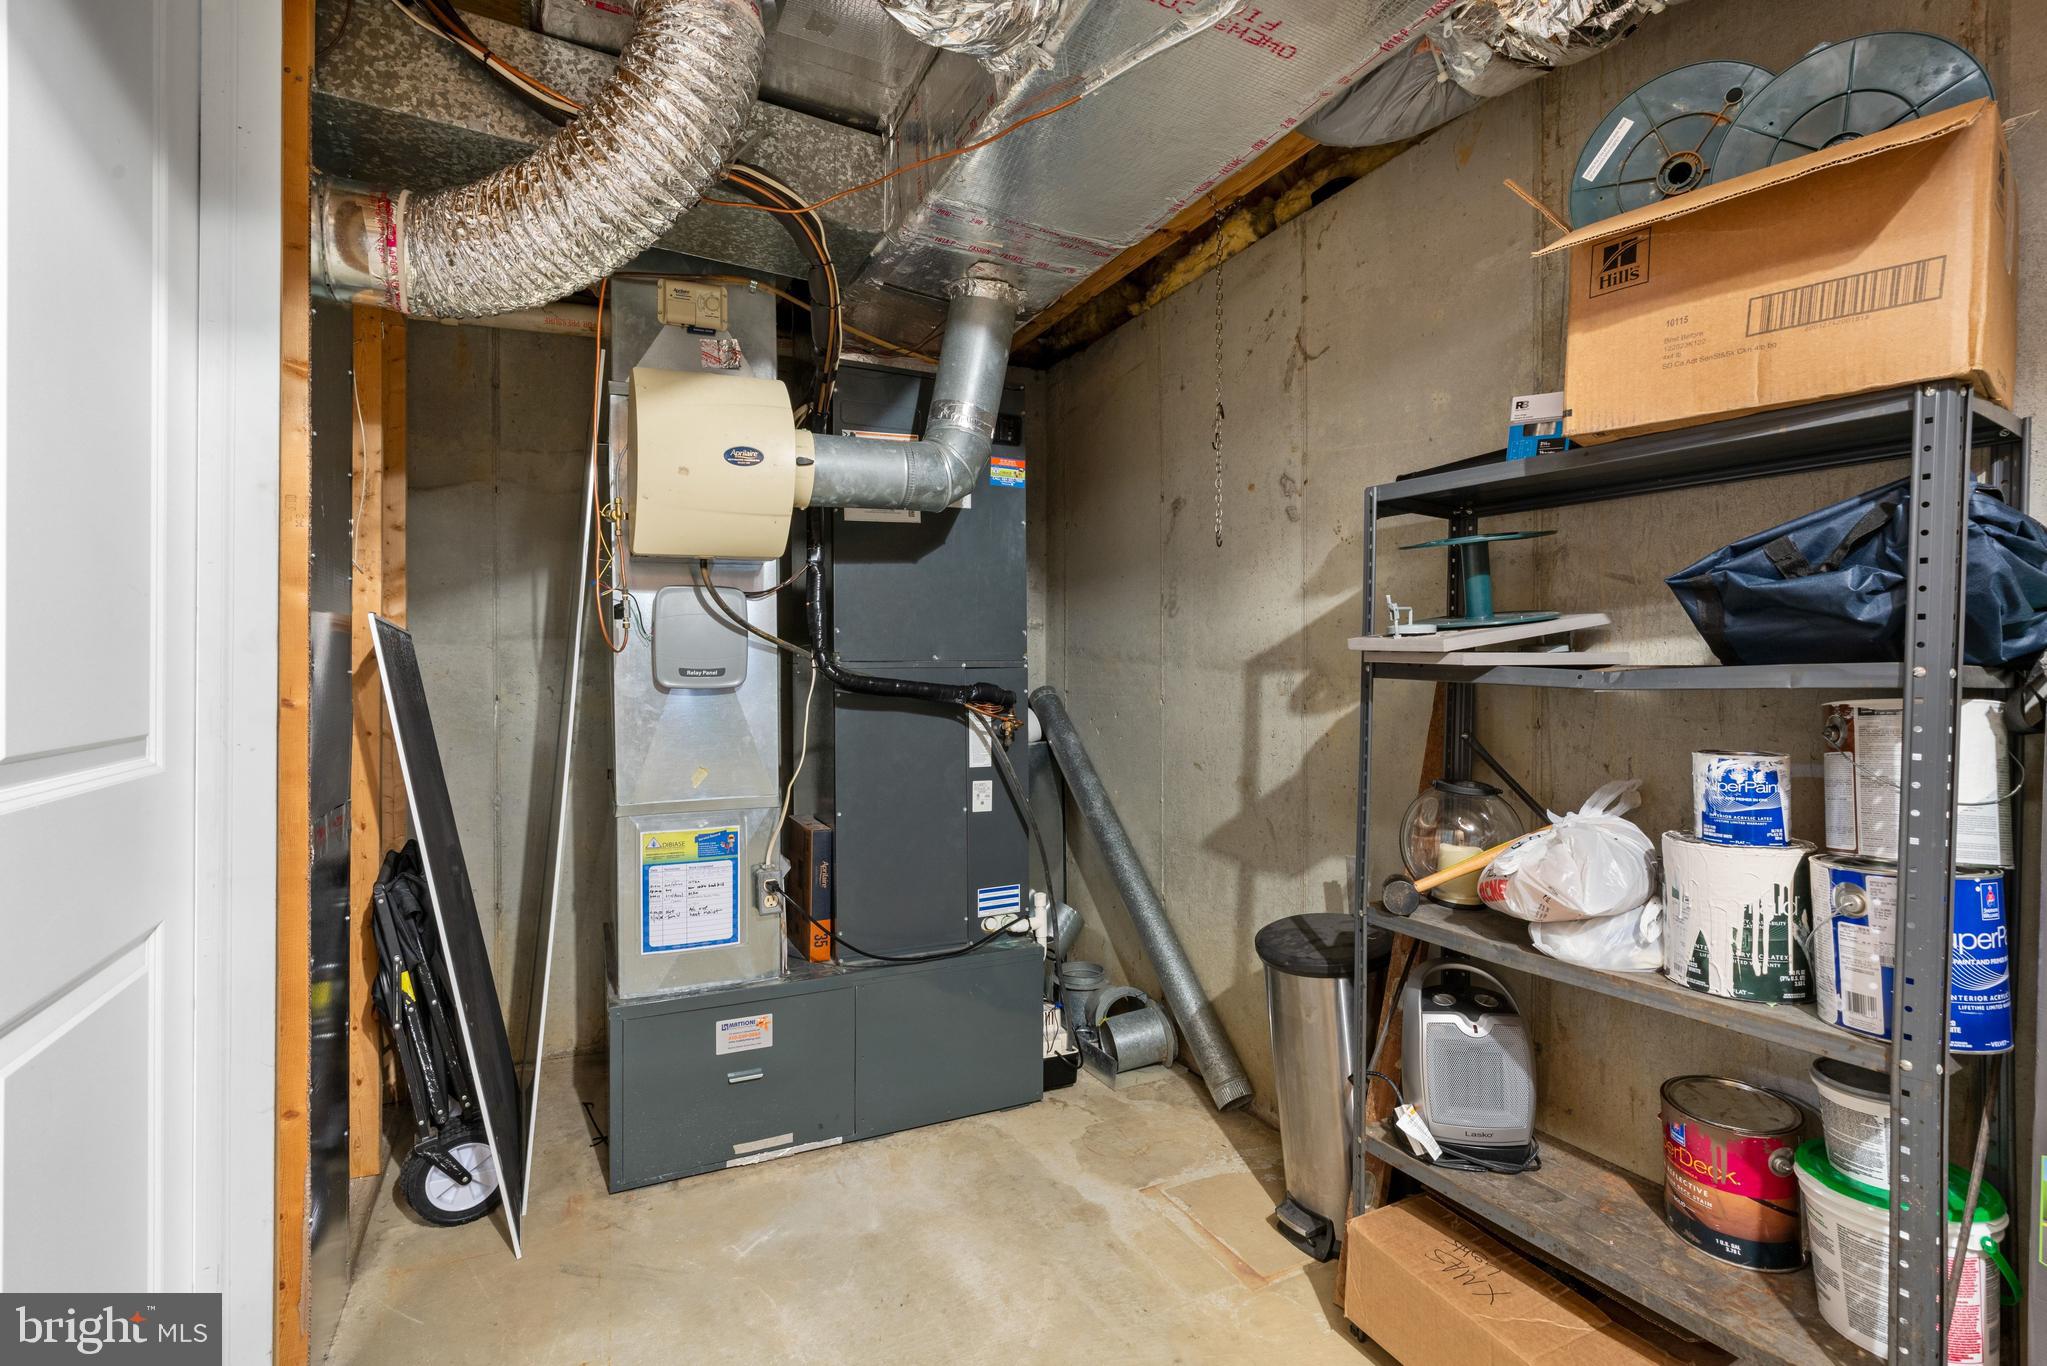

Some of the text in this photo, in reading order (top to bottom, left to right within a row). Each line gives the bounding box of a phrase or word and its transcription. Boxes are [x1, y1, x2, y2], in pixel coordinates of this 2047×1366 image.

[1600, 268, 1640, 290] Hill's
[1665, 315, 1690, 329] 10115
[686, 669, 701, 677] Relay
[813, 933, 829, 948] 35
[1464, 1130, 1494, 1138] Lasko
